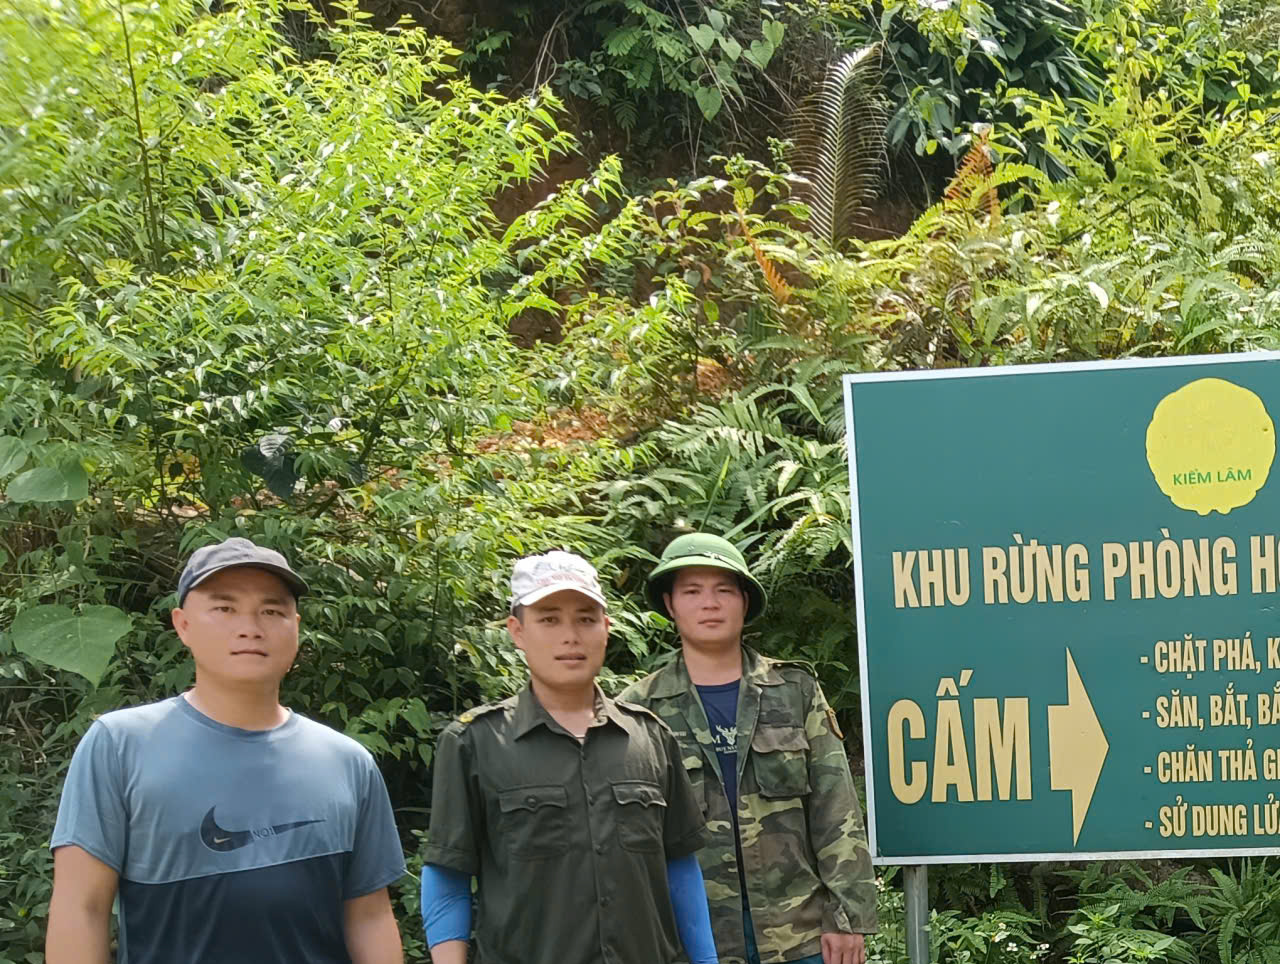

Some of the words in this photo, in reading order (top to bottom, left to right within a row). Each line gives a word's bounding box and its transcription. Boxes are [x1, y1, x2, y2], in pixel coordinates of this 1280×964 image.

[1216, 467, 1252, 483] LÂM
[893, 548, 971, 608] KHU
[983, 533, 1090, 604] RỪNG
[1103, 529, 1238, 601] PHÒNG
[1154, 633, 1207, 678] CHẶT
[1213, 631, 1261, 673] PHÁ,
[1156, 689, 1204, 729] SĂN,
[1210, 685, 1252, 729] BẮT,
[887, 669, 1032, 805] CẤM
[1157, 744, 1213, 783] CHĂN
[1218, 739, 1258, 781] THẢ
[1159, 795, 1188, 837] SỬ
